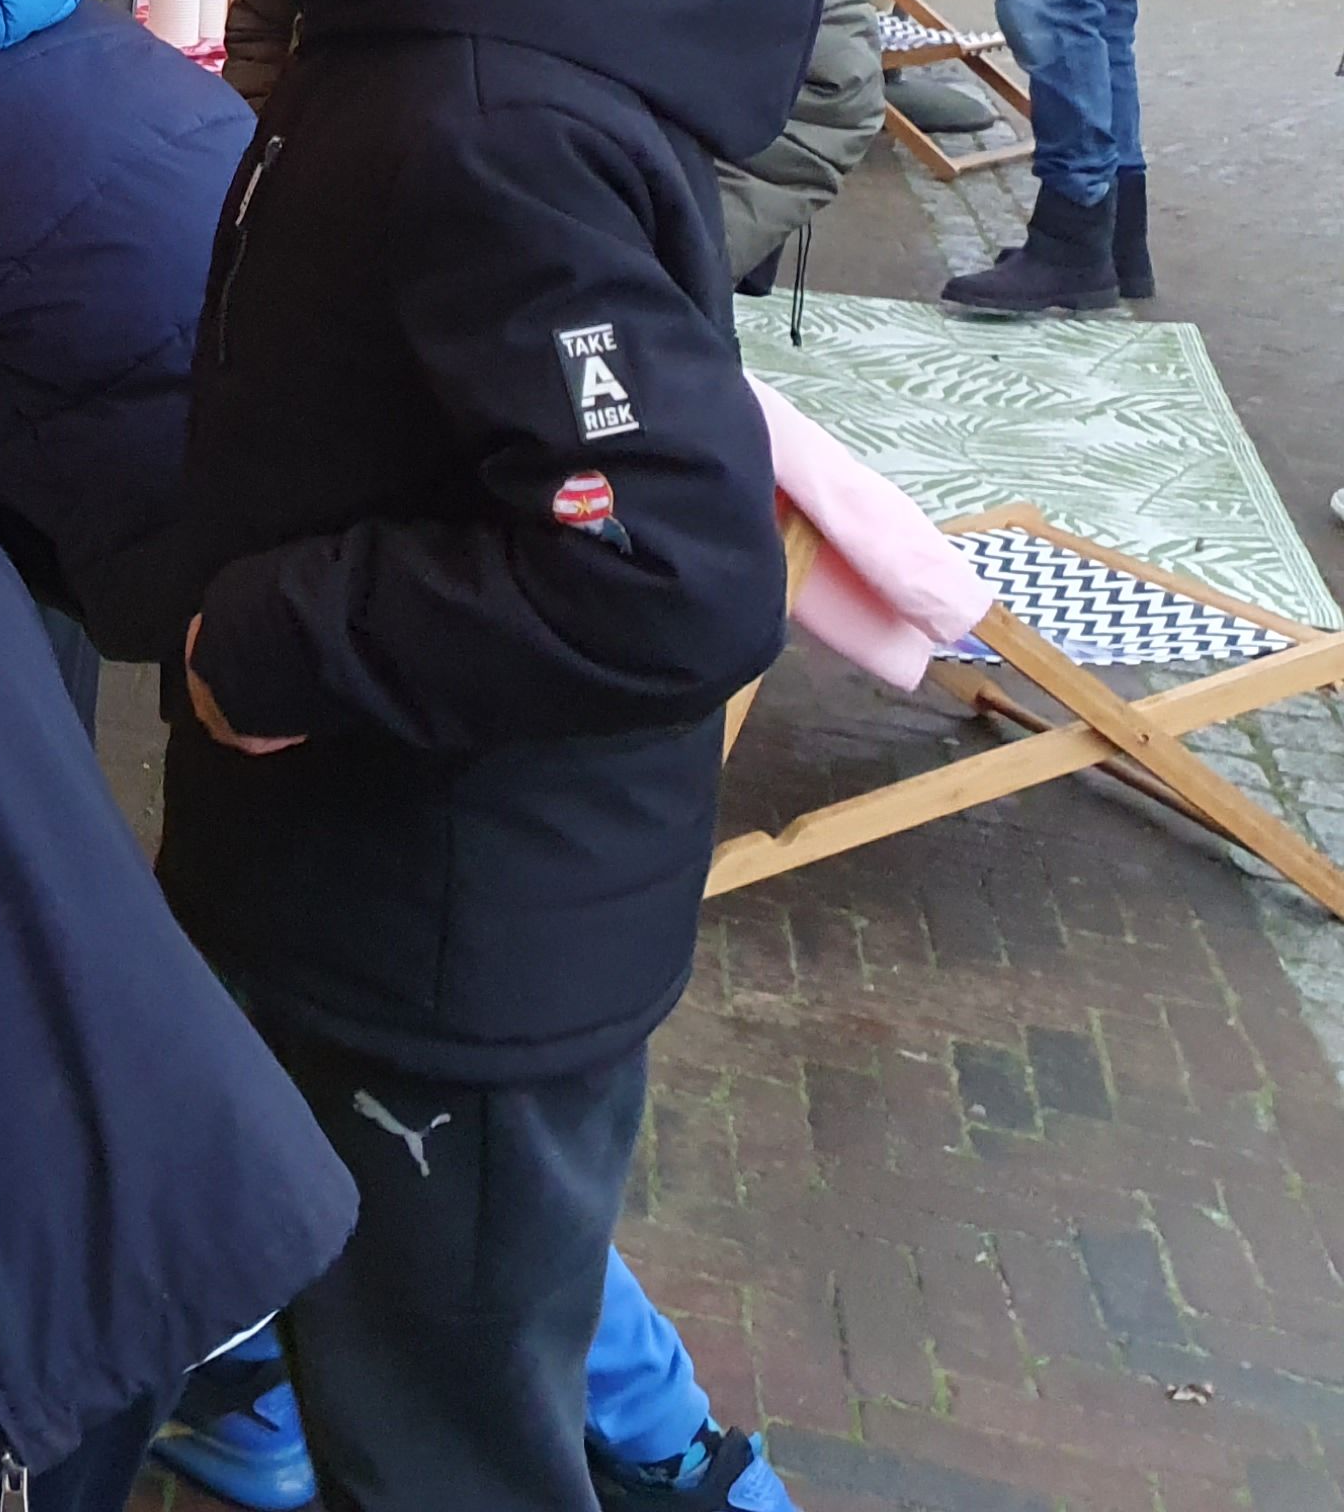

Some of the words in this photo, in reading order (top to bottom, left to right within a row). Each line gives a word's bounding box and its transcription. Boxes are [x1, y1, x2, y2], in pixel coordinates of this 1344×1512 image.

[562, 331, 618, 359] TAKE
[581, 355, 629, 408] A
[583, 402, 637, 432] RISK
